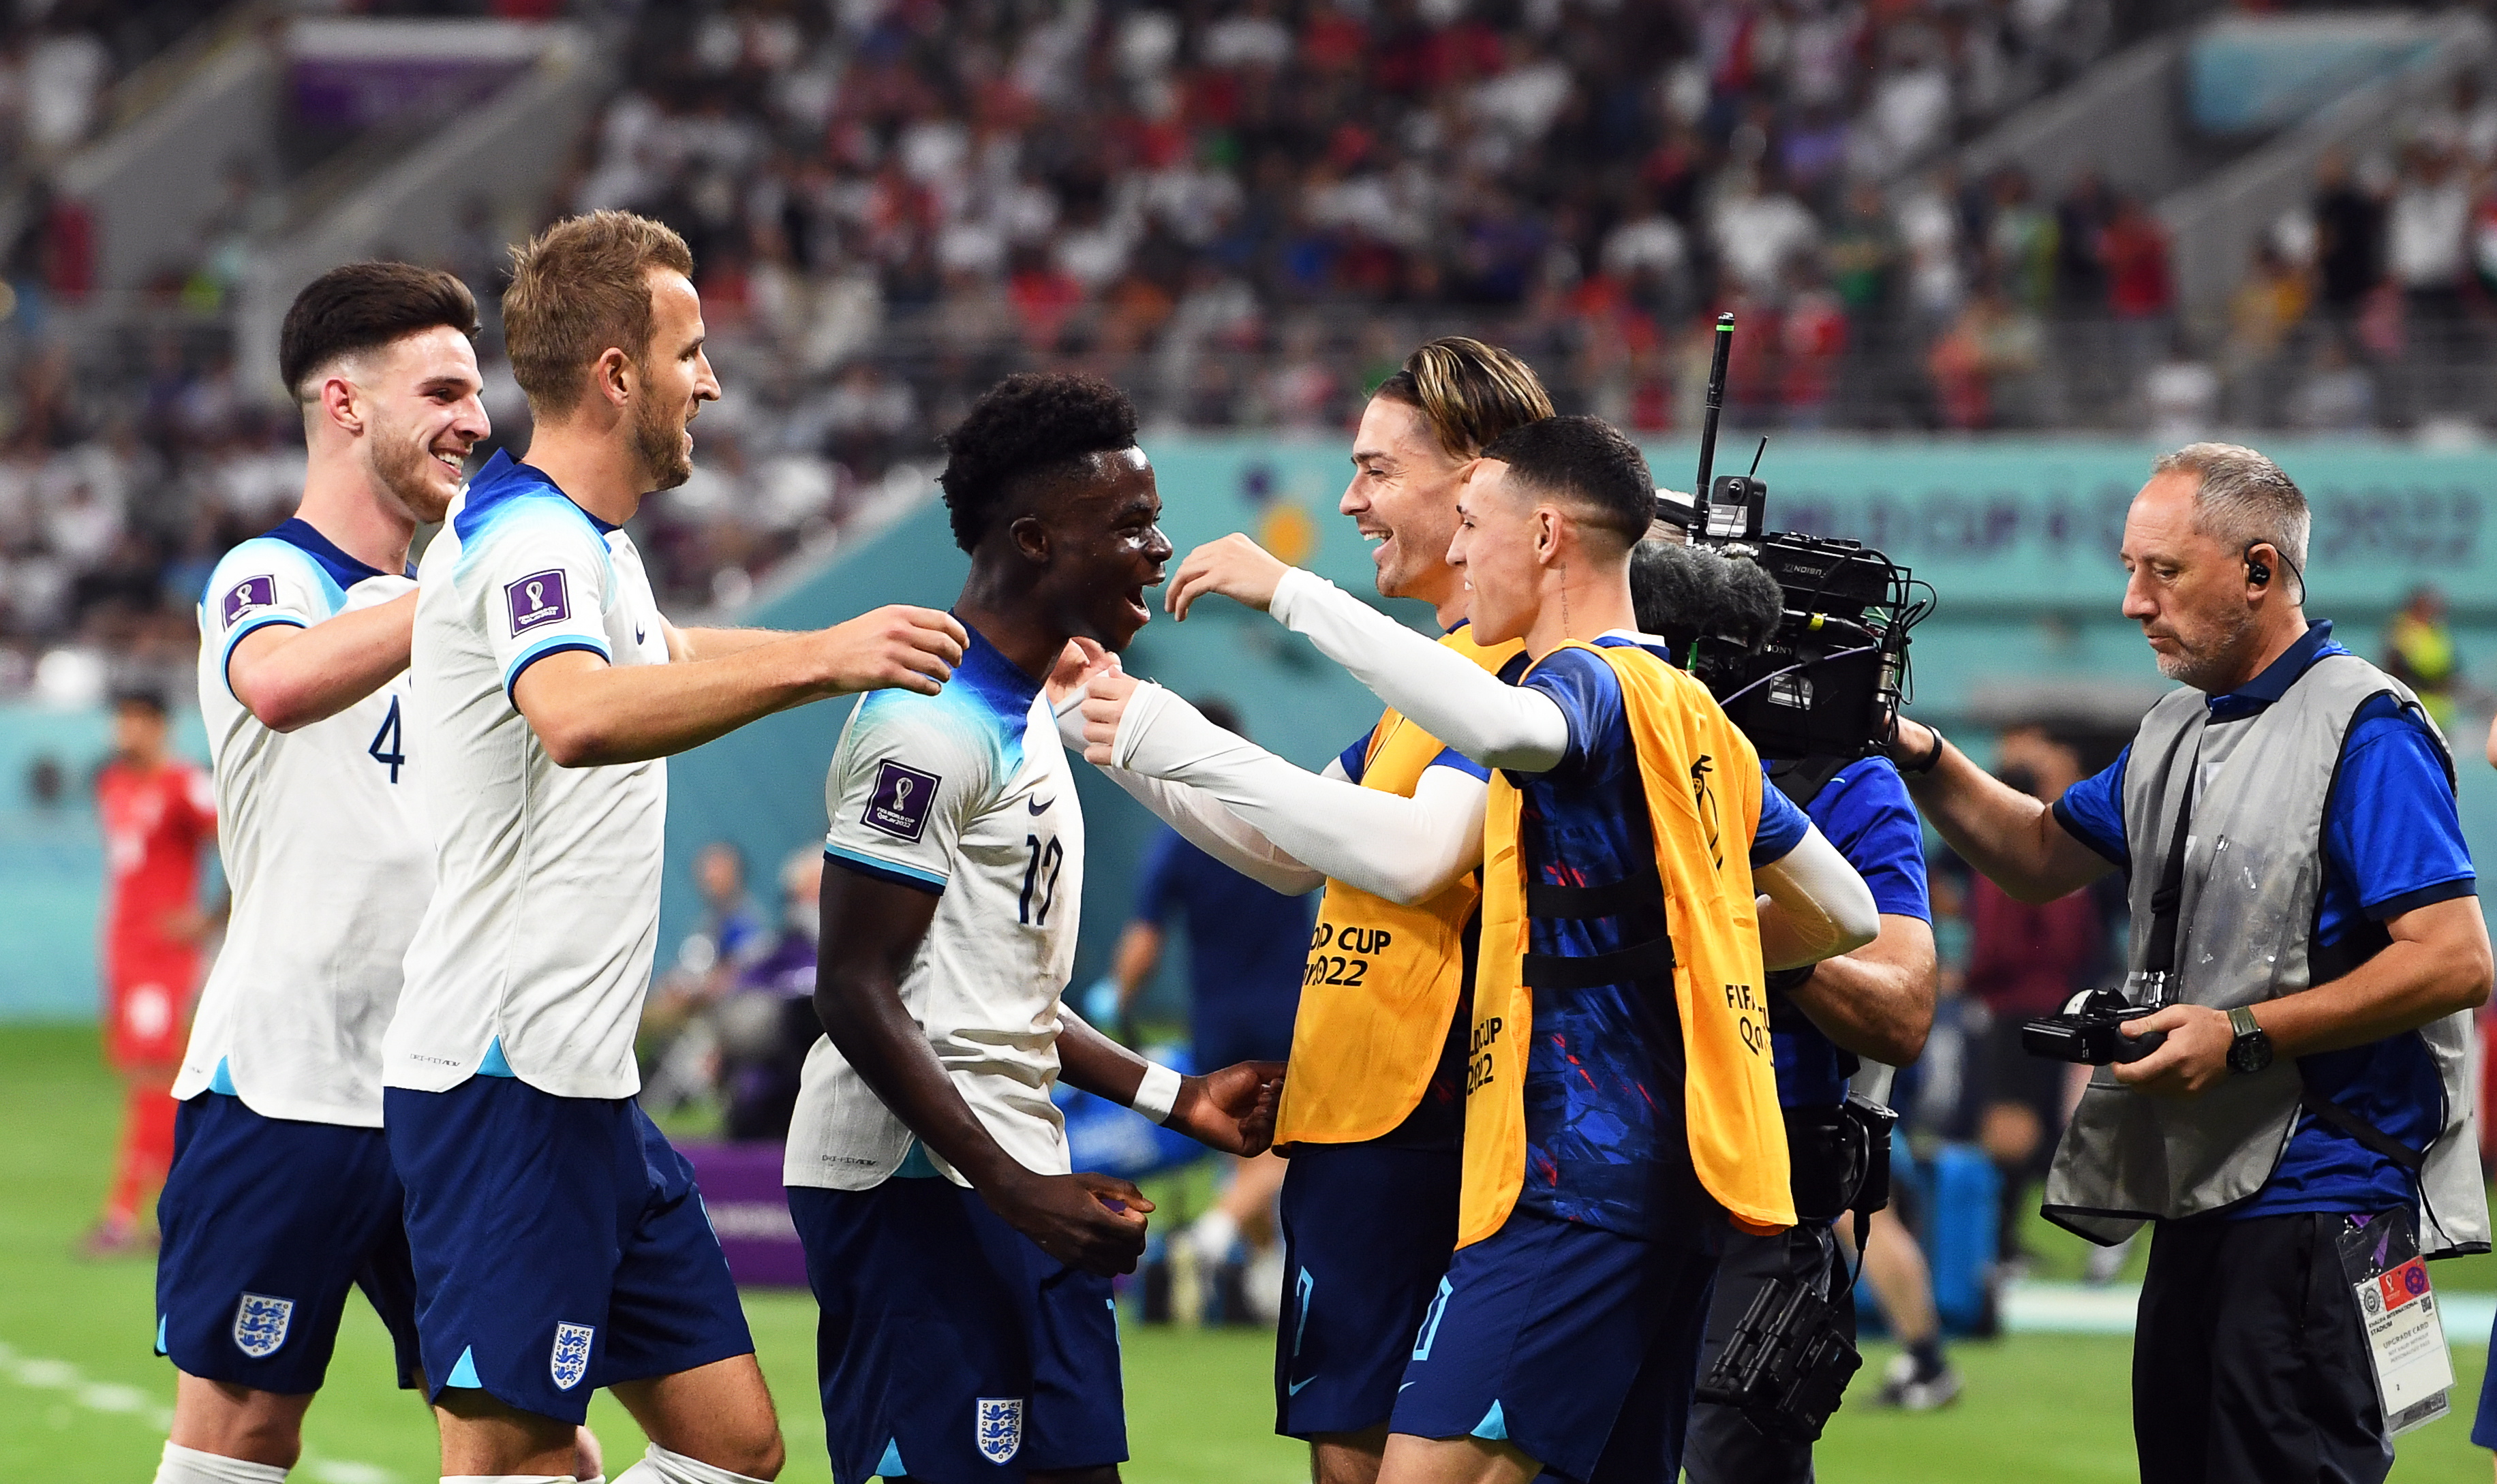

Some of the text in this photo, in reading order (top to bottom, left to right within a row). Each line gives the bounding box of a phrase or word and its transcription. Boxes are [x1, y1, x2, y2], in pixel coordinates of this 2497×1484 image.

[1764, 643, 1792, 655] SONY
[369, 694, 405, 784] 4
[1020, 834, 1063, 925] 17
[1338, 927, 1392, 955] CUP
[2370, 1320, 2393, 1336] STADIUM
[2383, 1321, 2429, 1349] UPGRADE CARD
